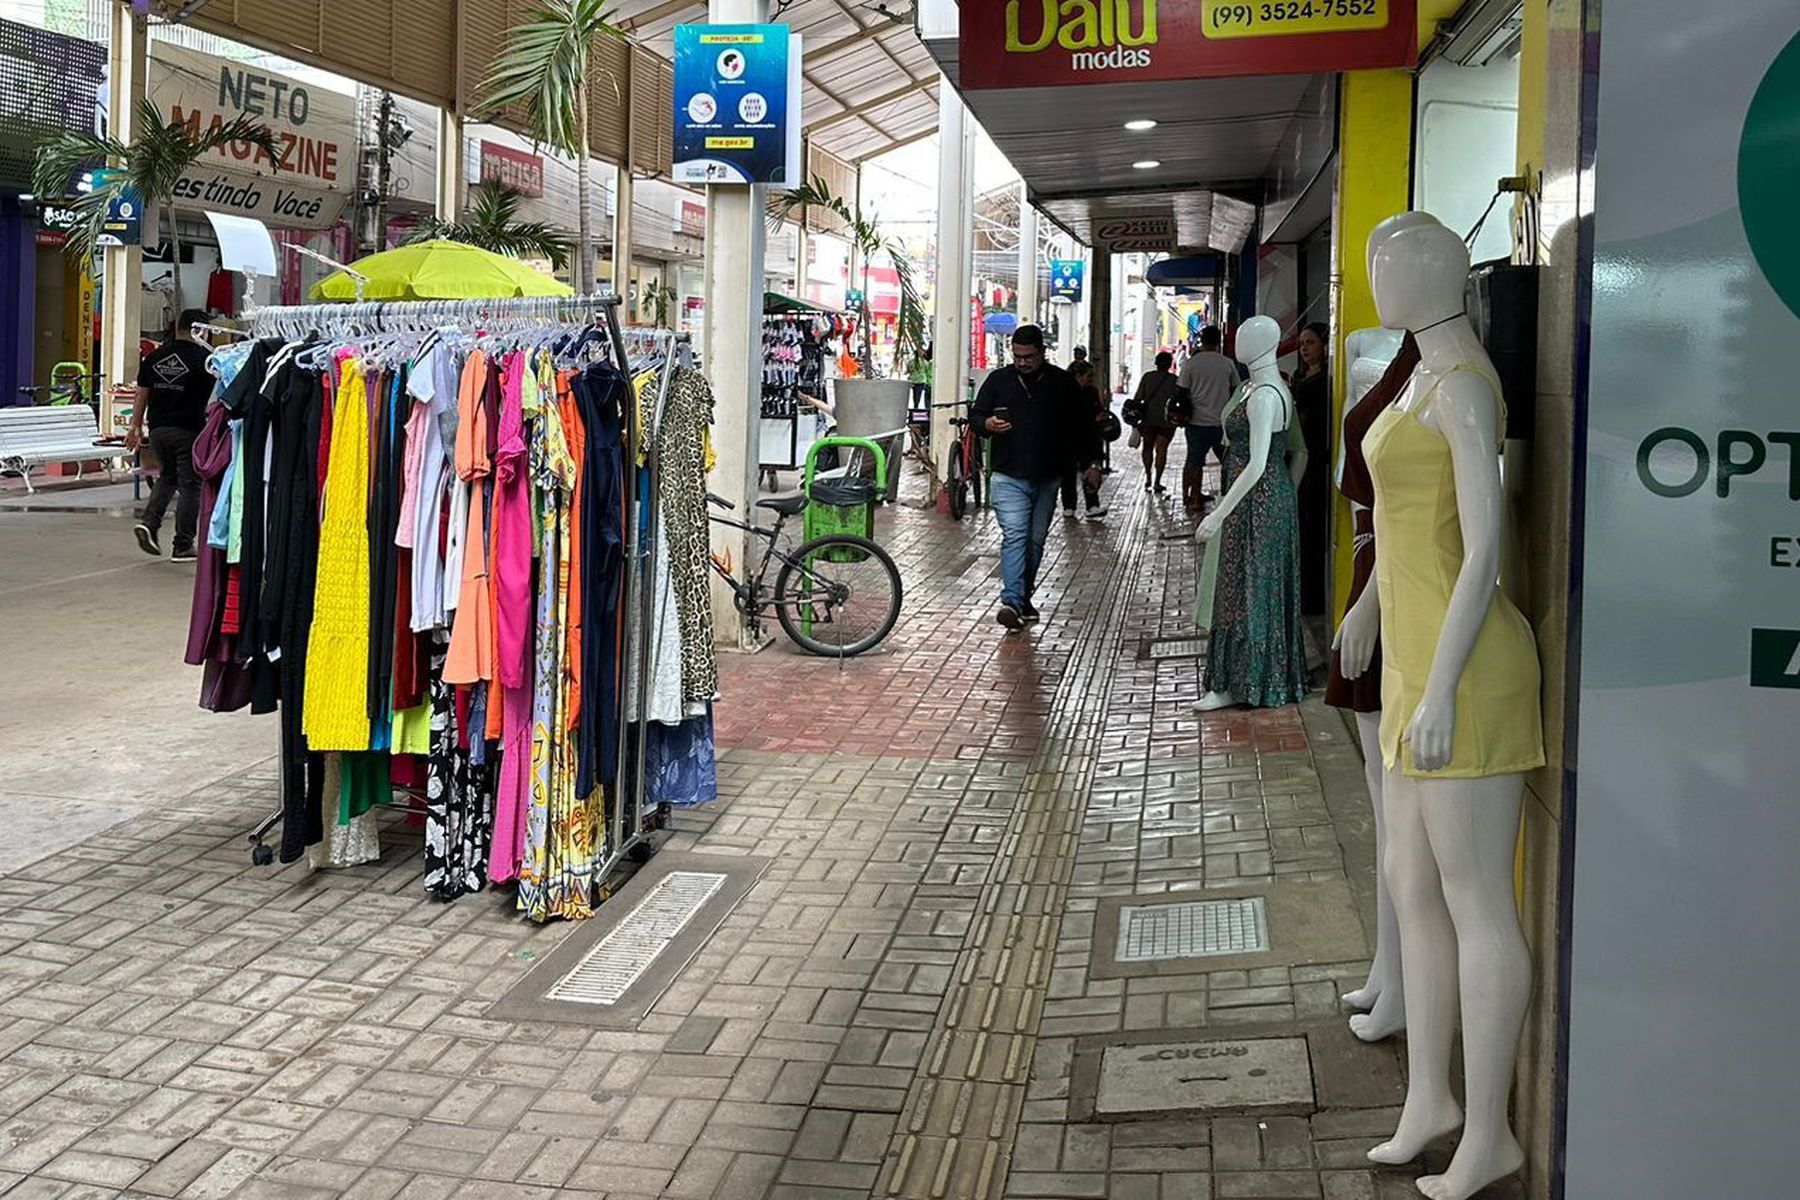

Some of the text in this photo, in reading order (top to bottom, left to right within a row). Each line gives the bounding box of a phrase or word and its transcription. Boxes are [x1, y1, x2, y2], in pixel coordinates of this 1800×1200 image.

[1213, 0, 1376, 28] (99) 3524-7552
[1072, 45, 1151, 70] modas
[218, 66, 309, 126] NETO
[172, 105, 337, 181] MAGAZINE
[483, 153, 541, 191] marisa
[172, 175, 323, 219] estindo Você
[1636, 427, 1800, 500] OPT
[1771, 536, 1800, 567] E
